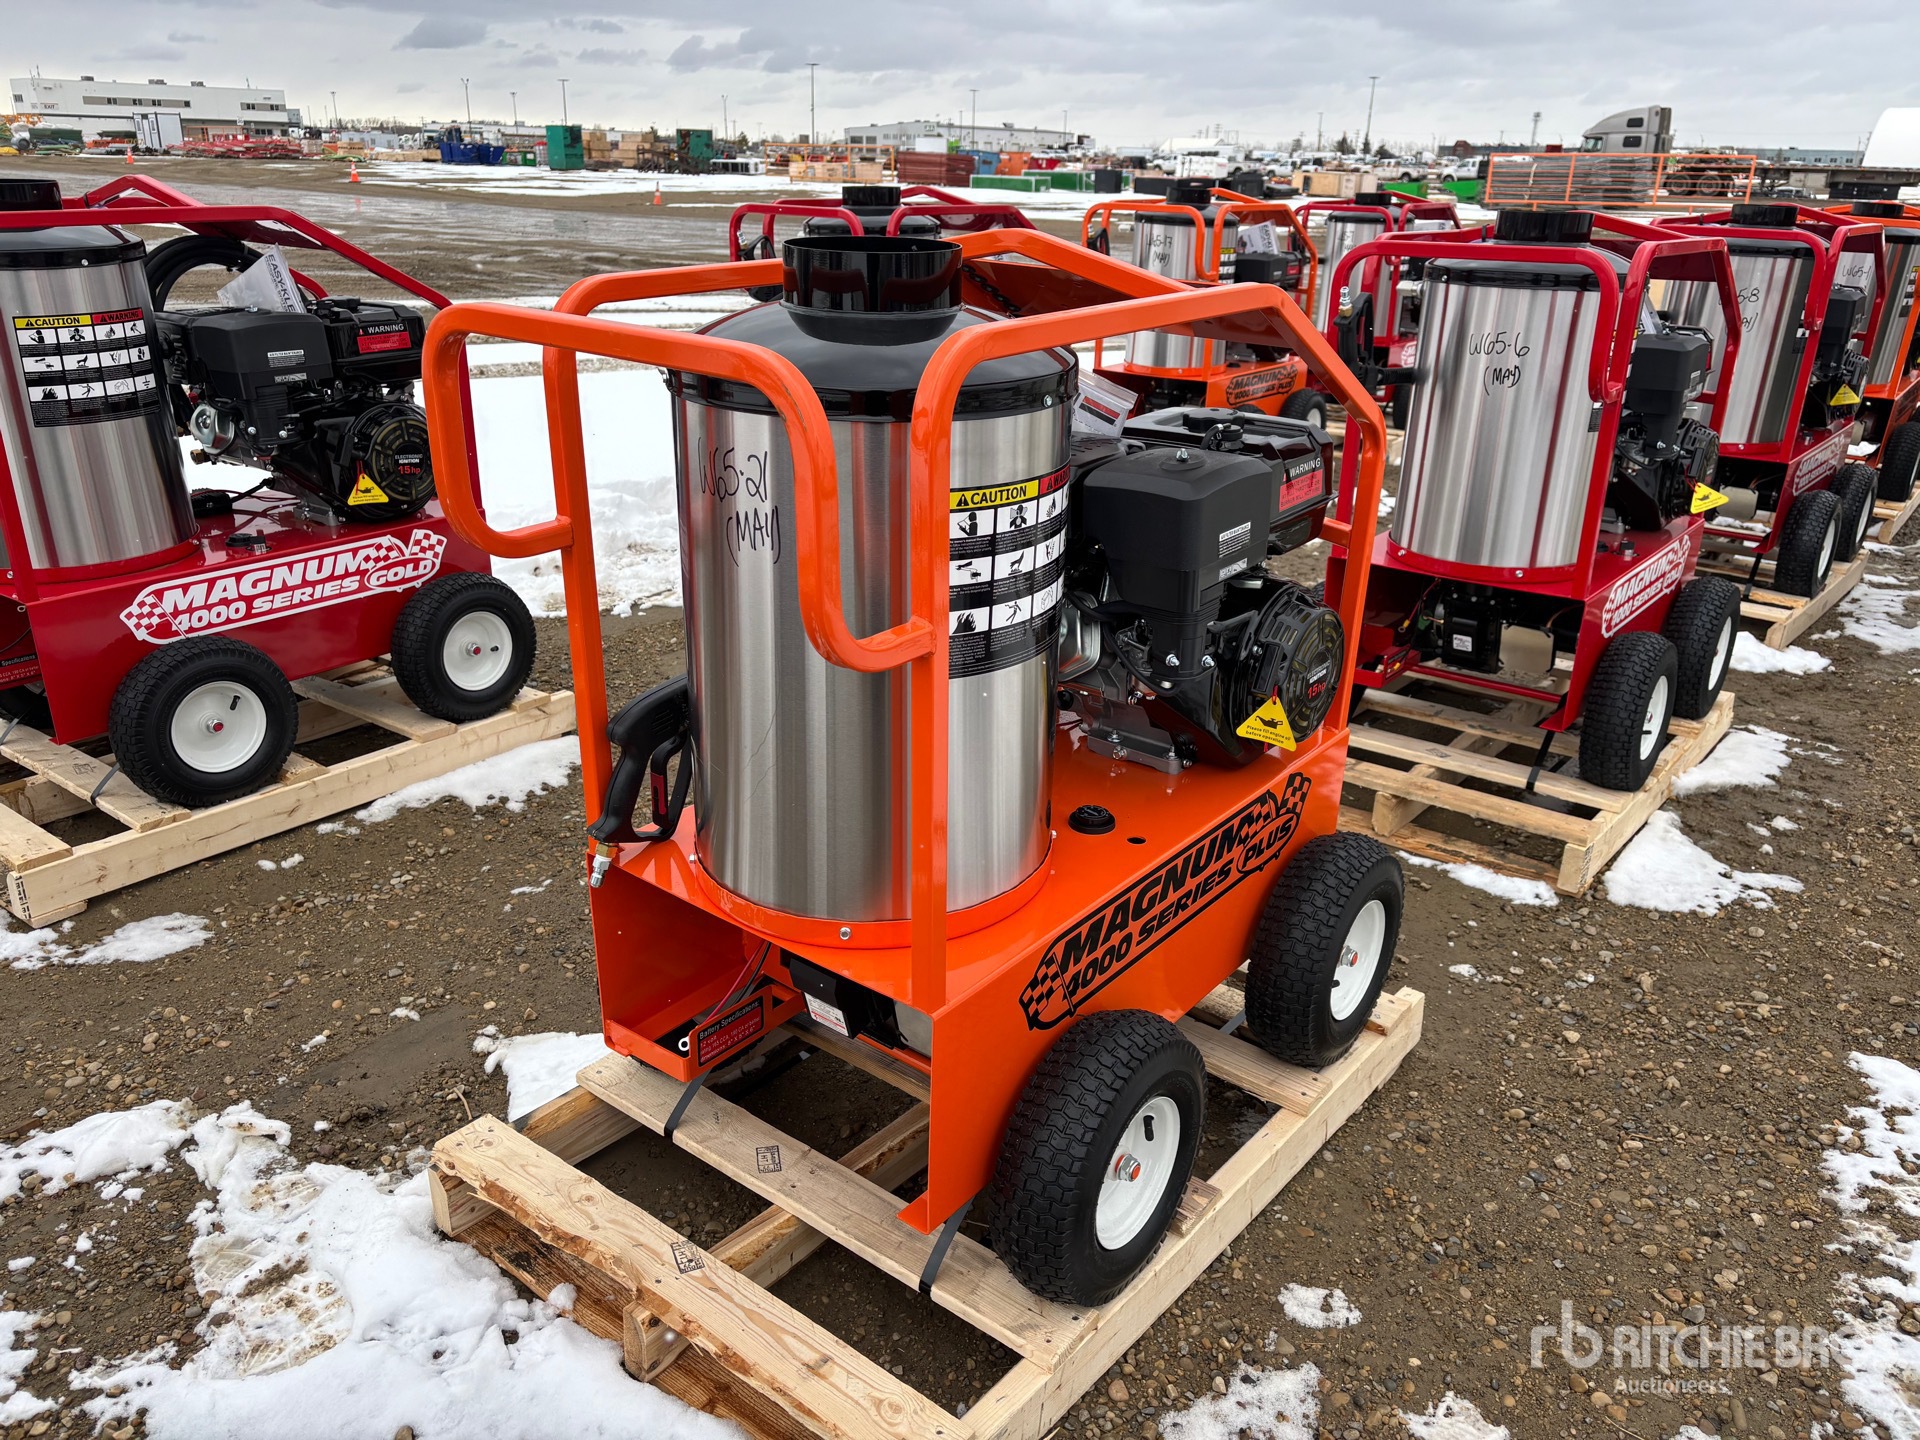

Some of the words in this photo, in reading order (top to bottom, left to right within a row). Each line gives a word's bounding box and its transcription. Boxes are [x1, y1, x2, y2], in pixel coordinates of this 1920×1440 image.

[268, 254, 297, 312] EASY-KLE
[35, 317, 81, 327] CAUTION
[107, 310, 140, 321] WARNING
[367, 324, 404, 334] WARNING
[1468, 331, 1531, 358] W65-6
[1233, 370, 1281, 391] MAGNUM
[1483, 364, 1522, 396] (MAY)
[1290, 458, 1321, 477] WARNING
[970, 485, 1027, 505] CAUTION
[161, 548, 374, 613] MAGNUM
[369, 560, 432, 586] GOLD
[1613, 555, 1669, 609] MAGNUM
[171, 602, 247, 632] 4000
[251, 576, 360, 614] SERIES
[1632, 577, 1664, 611] SERIES
[1245, 730, 1262, 738] before
[1246, 725, 1262, 733] Please
[1269, 730, 1285, 739] engine
[1058, 820, 1247, 975] MAGNUM
[1241, 818, 1295, 870] PLUS
[1062, 931, 1134, 1002] 4000
[1136, 858, 1234, 948] SERIES
[700, 1024, 720, 1040] Battery
